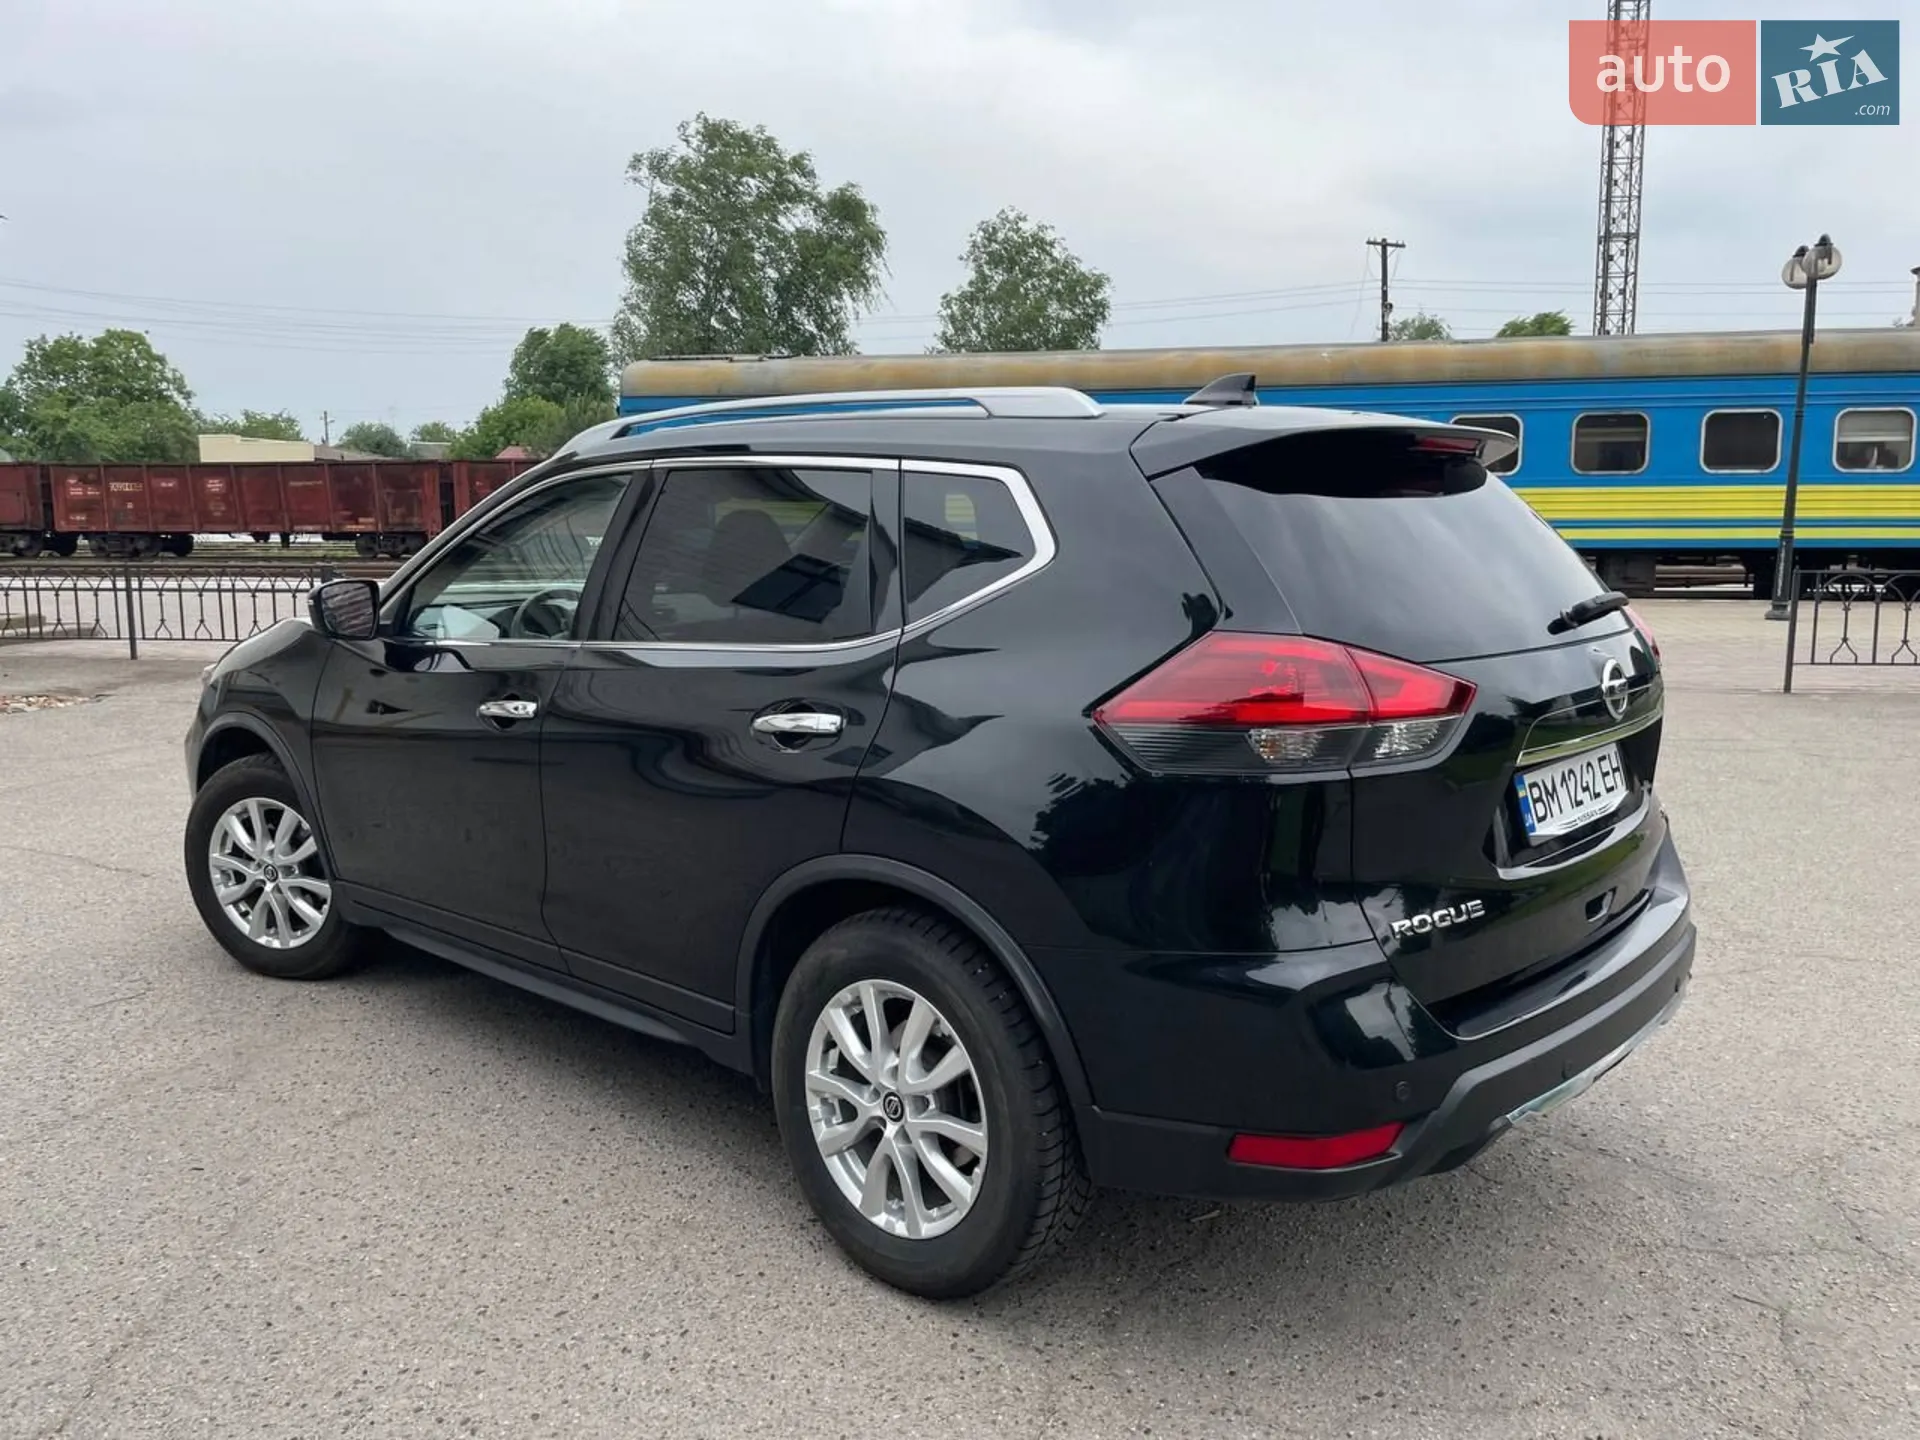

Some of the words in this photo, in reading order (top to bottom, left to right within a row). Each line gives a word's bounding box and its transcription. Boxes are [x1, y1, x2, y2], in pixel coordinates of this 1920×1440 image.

[1528, 775, 1563, 823] BM
[1560, 760, 1601, 810] 1242
[1597, 750, 1625, 794] EH
[1391, 899, 1486, 939] ROGUE
